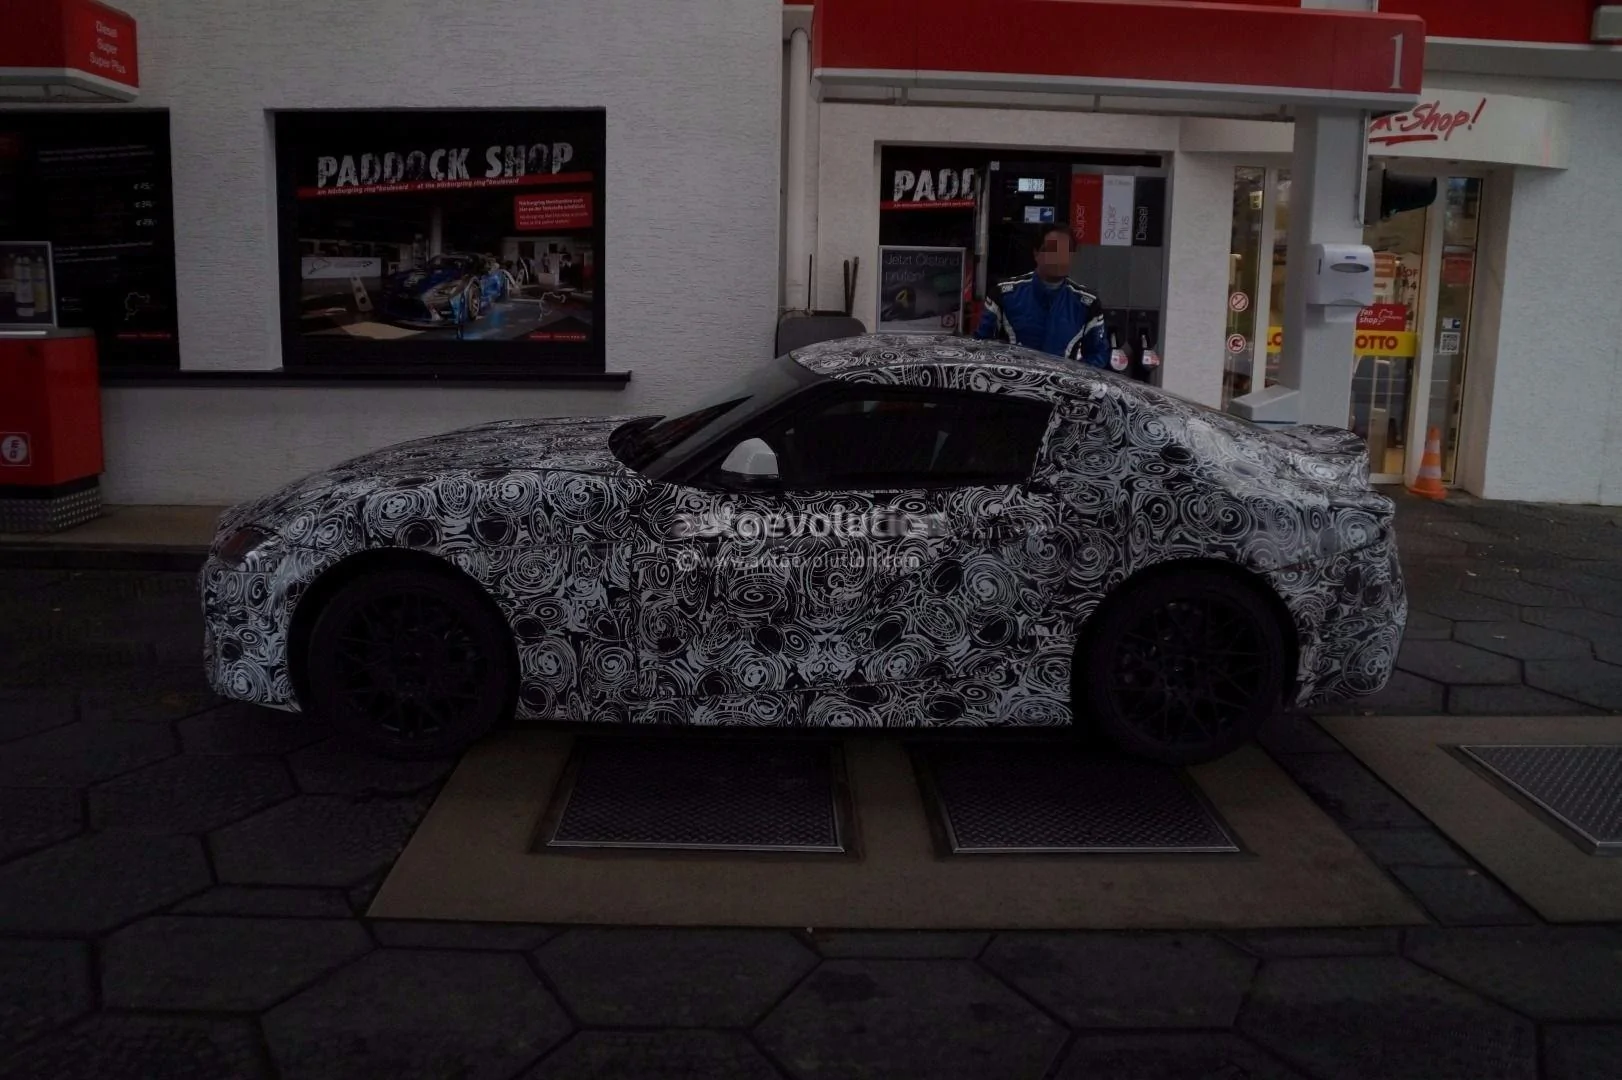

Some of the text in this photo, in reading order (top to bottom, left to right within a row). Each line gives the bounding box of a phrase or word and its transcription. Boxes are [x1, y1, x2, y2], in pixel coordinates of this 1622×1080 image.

[1389, 32, 1404, 89] 1
[316, 141, 574, 188] PADDOCK SHOP
[1073, 203, 1087, 240] Super
[1103, 205, 1117, 240] Super
[1135, 206, 1149, 240] Diesel
[1356, 335, 1398, 349] OTTO
